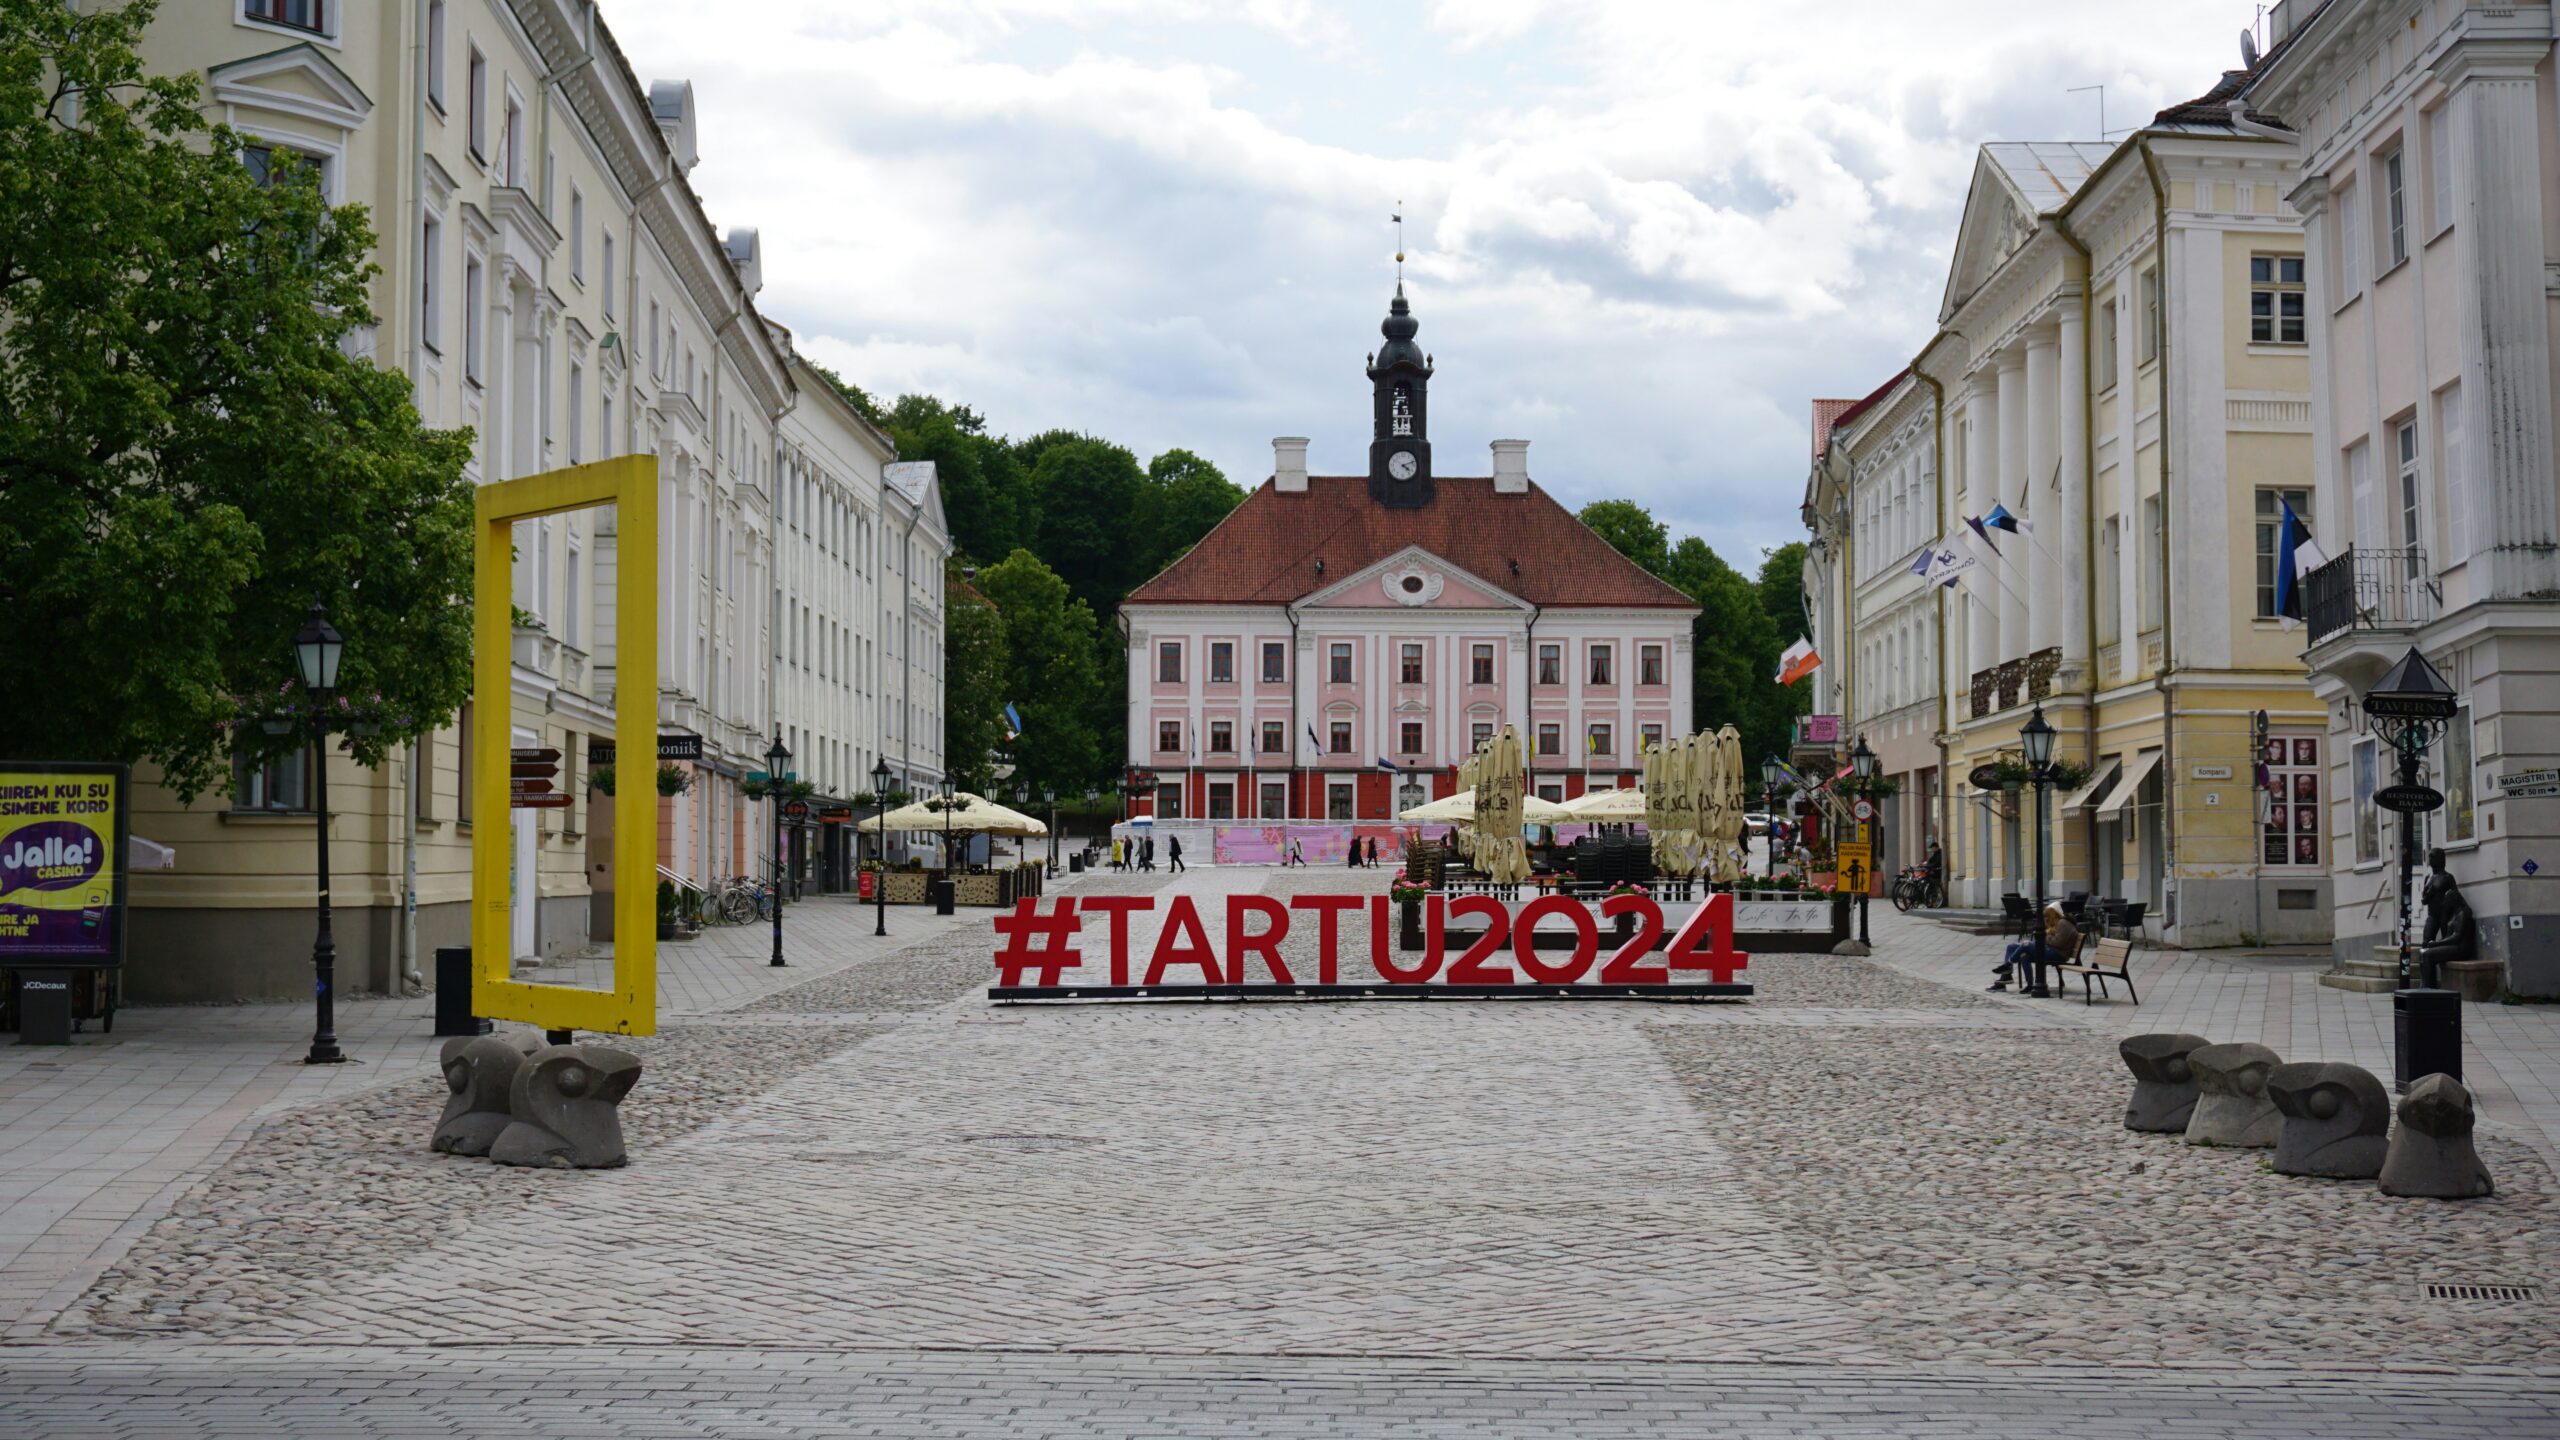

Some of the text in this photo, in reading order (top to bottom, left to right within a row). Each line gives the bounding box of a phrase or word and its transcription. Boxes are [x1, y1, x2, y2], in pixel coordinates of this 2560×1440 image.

[2373, 700, 2448, 713] TAVERNA
[2500, 773, 2545, 786] MAGISTRI
[55, 784, 81, 798] KUI
[88, 783, 109, 797] SU
[2507, 788, 2525, 797] WC
[2528, 788, 2537, 796] 50
[2209, 794, 2217, 803] 2
[0, 800, 109, 816] SIMENE KORD
[4, 837, 93, 869] Jalla!
[37, 865, 84, 879] CASINO
[23, 914, 39, 925] JA
[0, 926, 29, 936] HTNE
[993, 893, 1748, 984] #TARTU2024
[24, 981, 67, 990] JCDecaux
